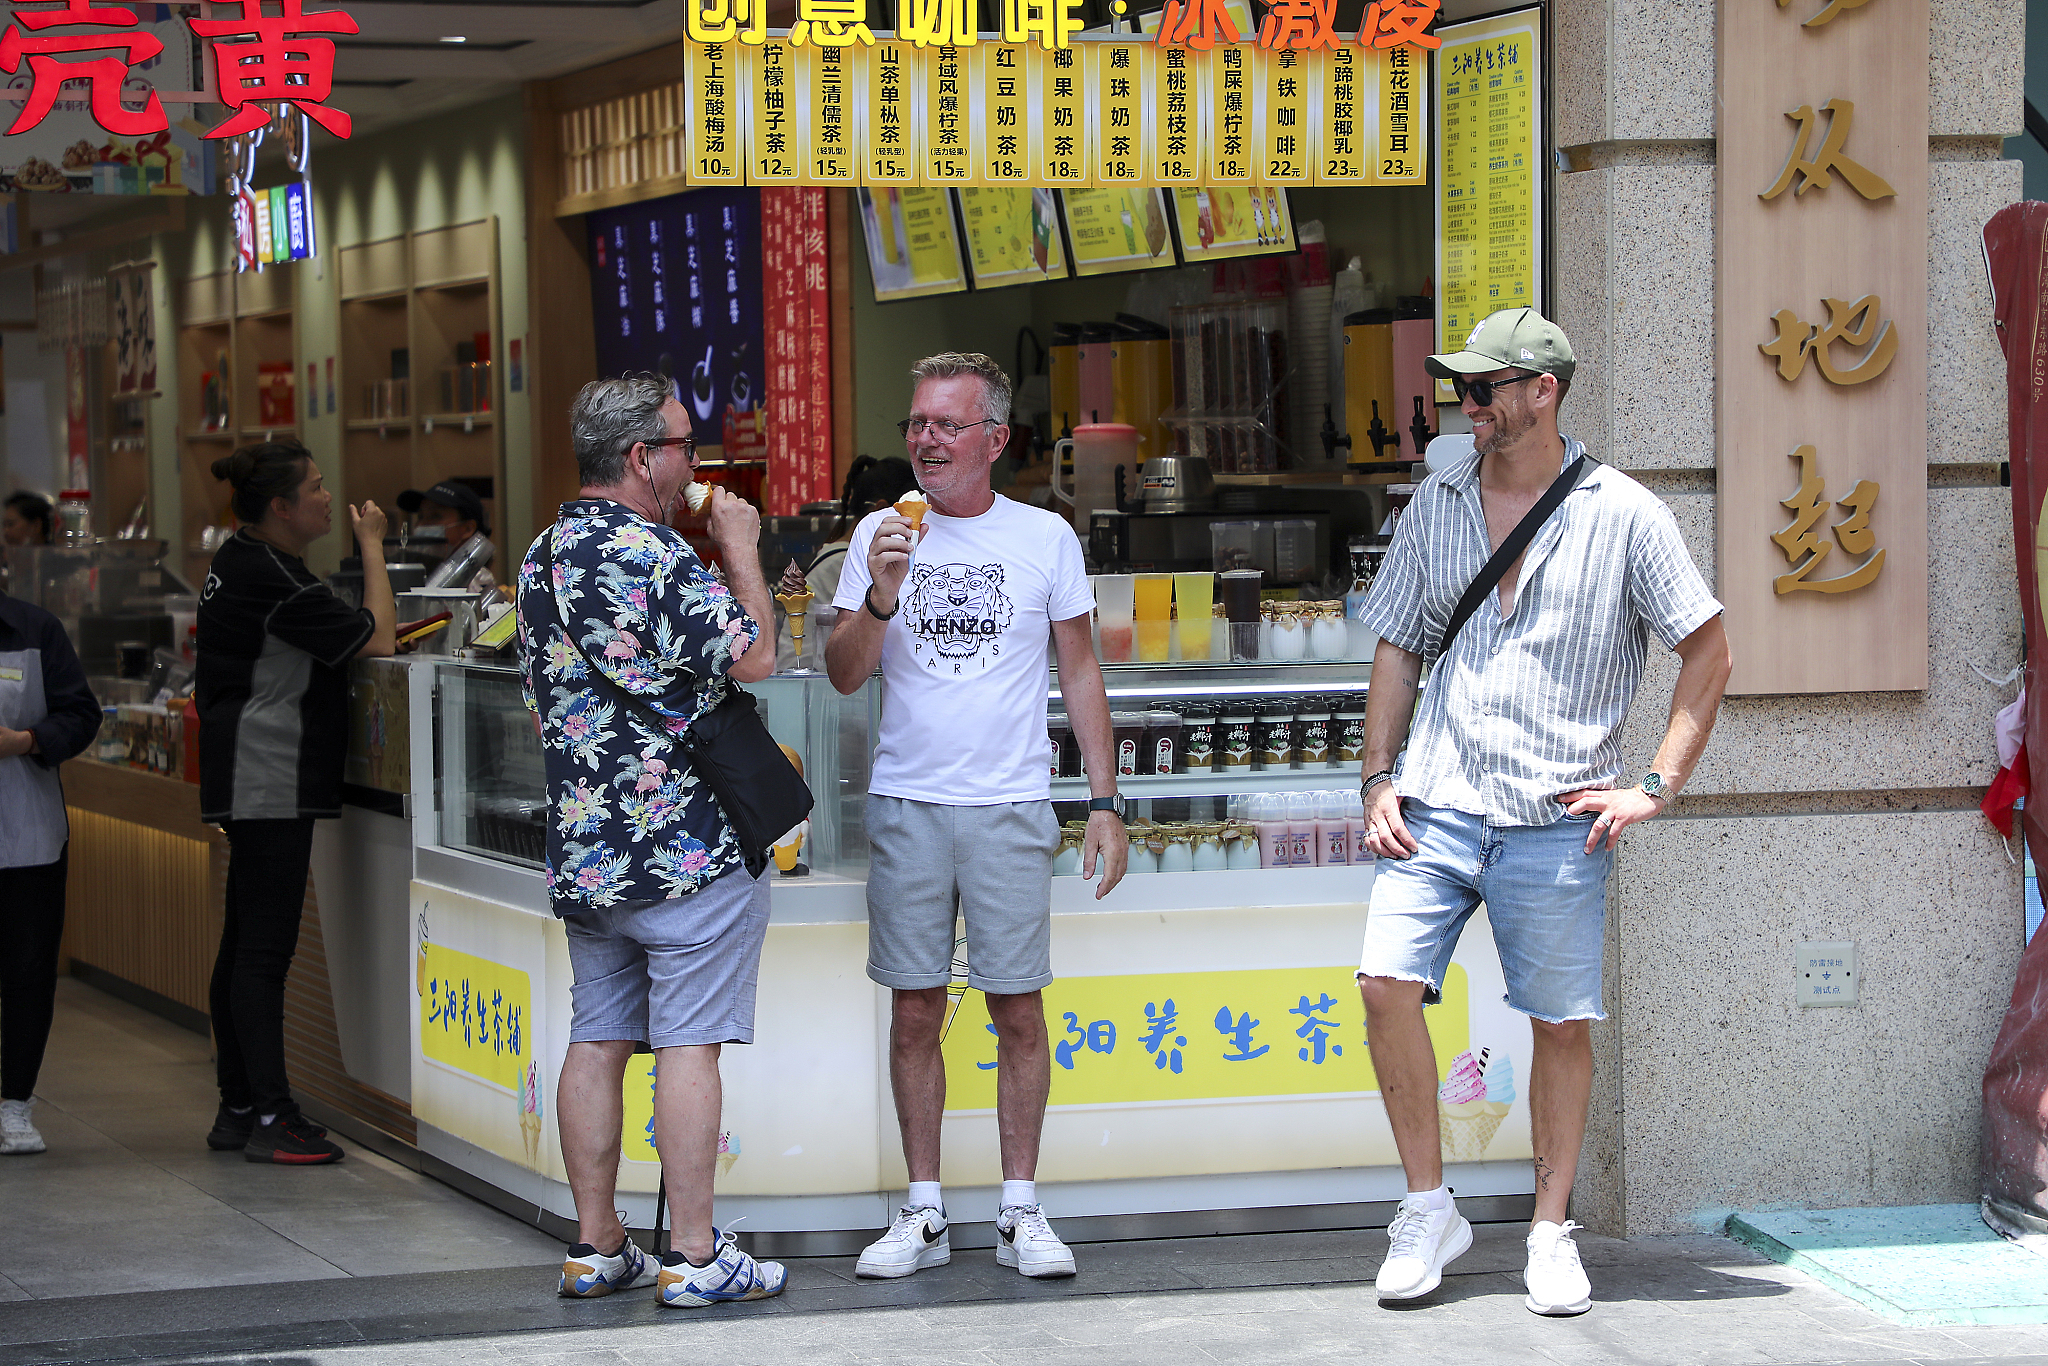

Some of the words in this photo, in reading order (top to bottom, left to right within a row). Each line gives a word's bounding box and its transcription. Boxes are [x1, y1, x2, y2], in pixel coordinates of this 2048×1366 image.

[1452, 42, 1519, 75] 三阳养生茶铺
[703, 43, 726, 153] 老上海酸梅汤
[879, 46, 900, 144] 山茶单枞茶
[937, 46, 959, 144] 异域风爆柠茶
[996, 47, 1018, 156] 红豆奶茶
[1053, 48, 1074, 156] 椰果奶茶
[1110, 48, 1131, 156] 爆珠奶茶
[1166, 48, 1187, 156] 蜜桃荔枝茶
[1223, 48, 1243, 156] 鸭屎爆柠茶
[1276, 48, 1298, 155] 拿铁咖啡
[1333, 48, 1354, 155] 马蹄桃胶椰乳
[1389, 48, 1410, 154] 桂花酒雪耳
[699, 158, 731, 177] 10元
[759, 158, 792, 177] 12元
[816, 159, 847, 178] 15元
[874, 159, 906, 178] 15元
[933, 159, 965, 178] 15元
[991, 160, 1023, 178] 18元
[1048, 160, 1079, 178] 18元
[1105, 160, 1135, 178] 18元
[1161, 160, 1191, 178] 18元
[1218, 160, 1246, 178] 18元
[1270, 160, 1301, 178] 22元
[1327, 159, 1359, 177] 23元
[1383, 159, 1413, 176] 23元
[920, 618, 997, 634] KENZO
[915, 643, 1000, 674] PARIS
[1809, 959, 1844, 968] 防雷接地
[1813, 985, 1841, 995] 测试点
[428, 977, 522, 1057] 三阳养生茶铺
[976, 992, 1426, 1074] 阳养生茶
